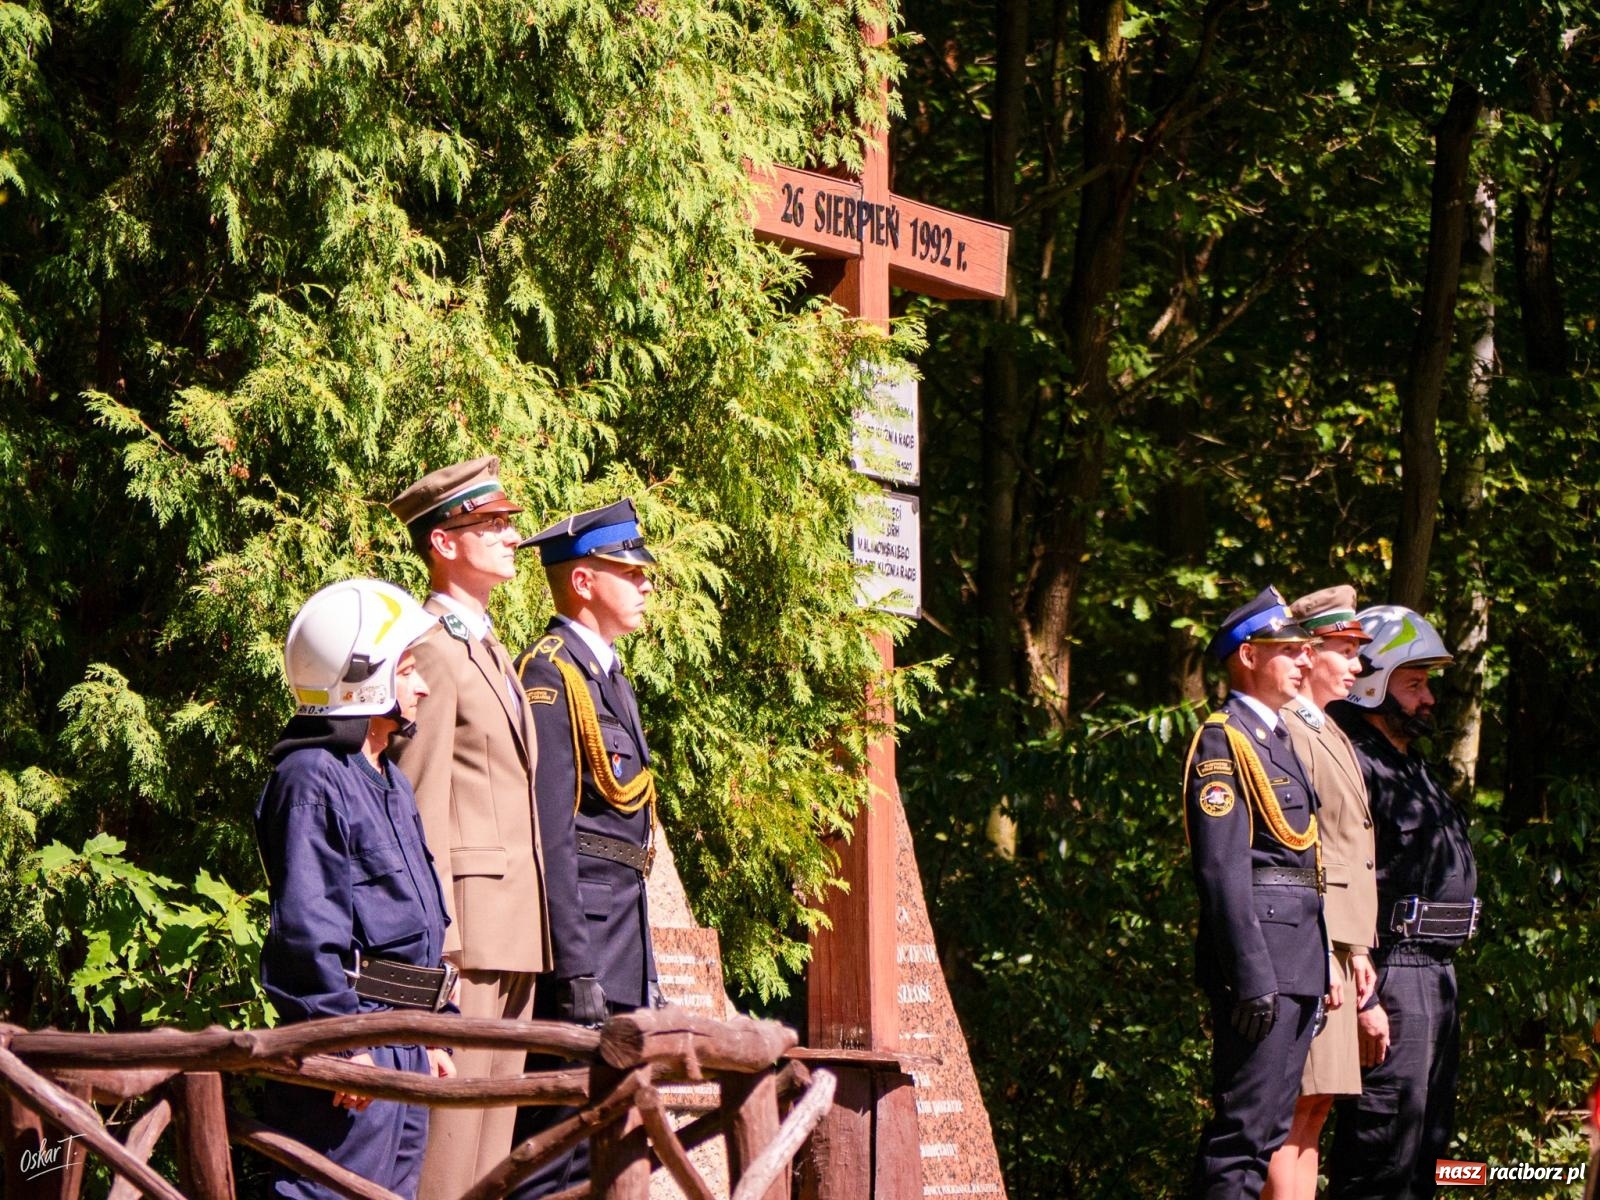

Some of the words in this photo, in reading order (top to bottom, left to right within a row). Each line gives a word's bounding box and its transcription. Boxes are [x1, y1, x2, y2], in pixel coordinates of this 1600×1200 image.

[781, 183, 804, 227] 26
[814, 190, 899, 250] SIERPIEŃ
[910, 217, 953, 267] 1992
[956, 241, 967, 272] r.
